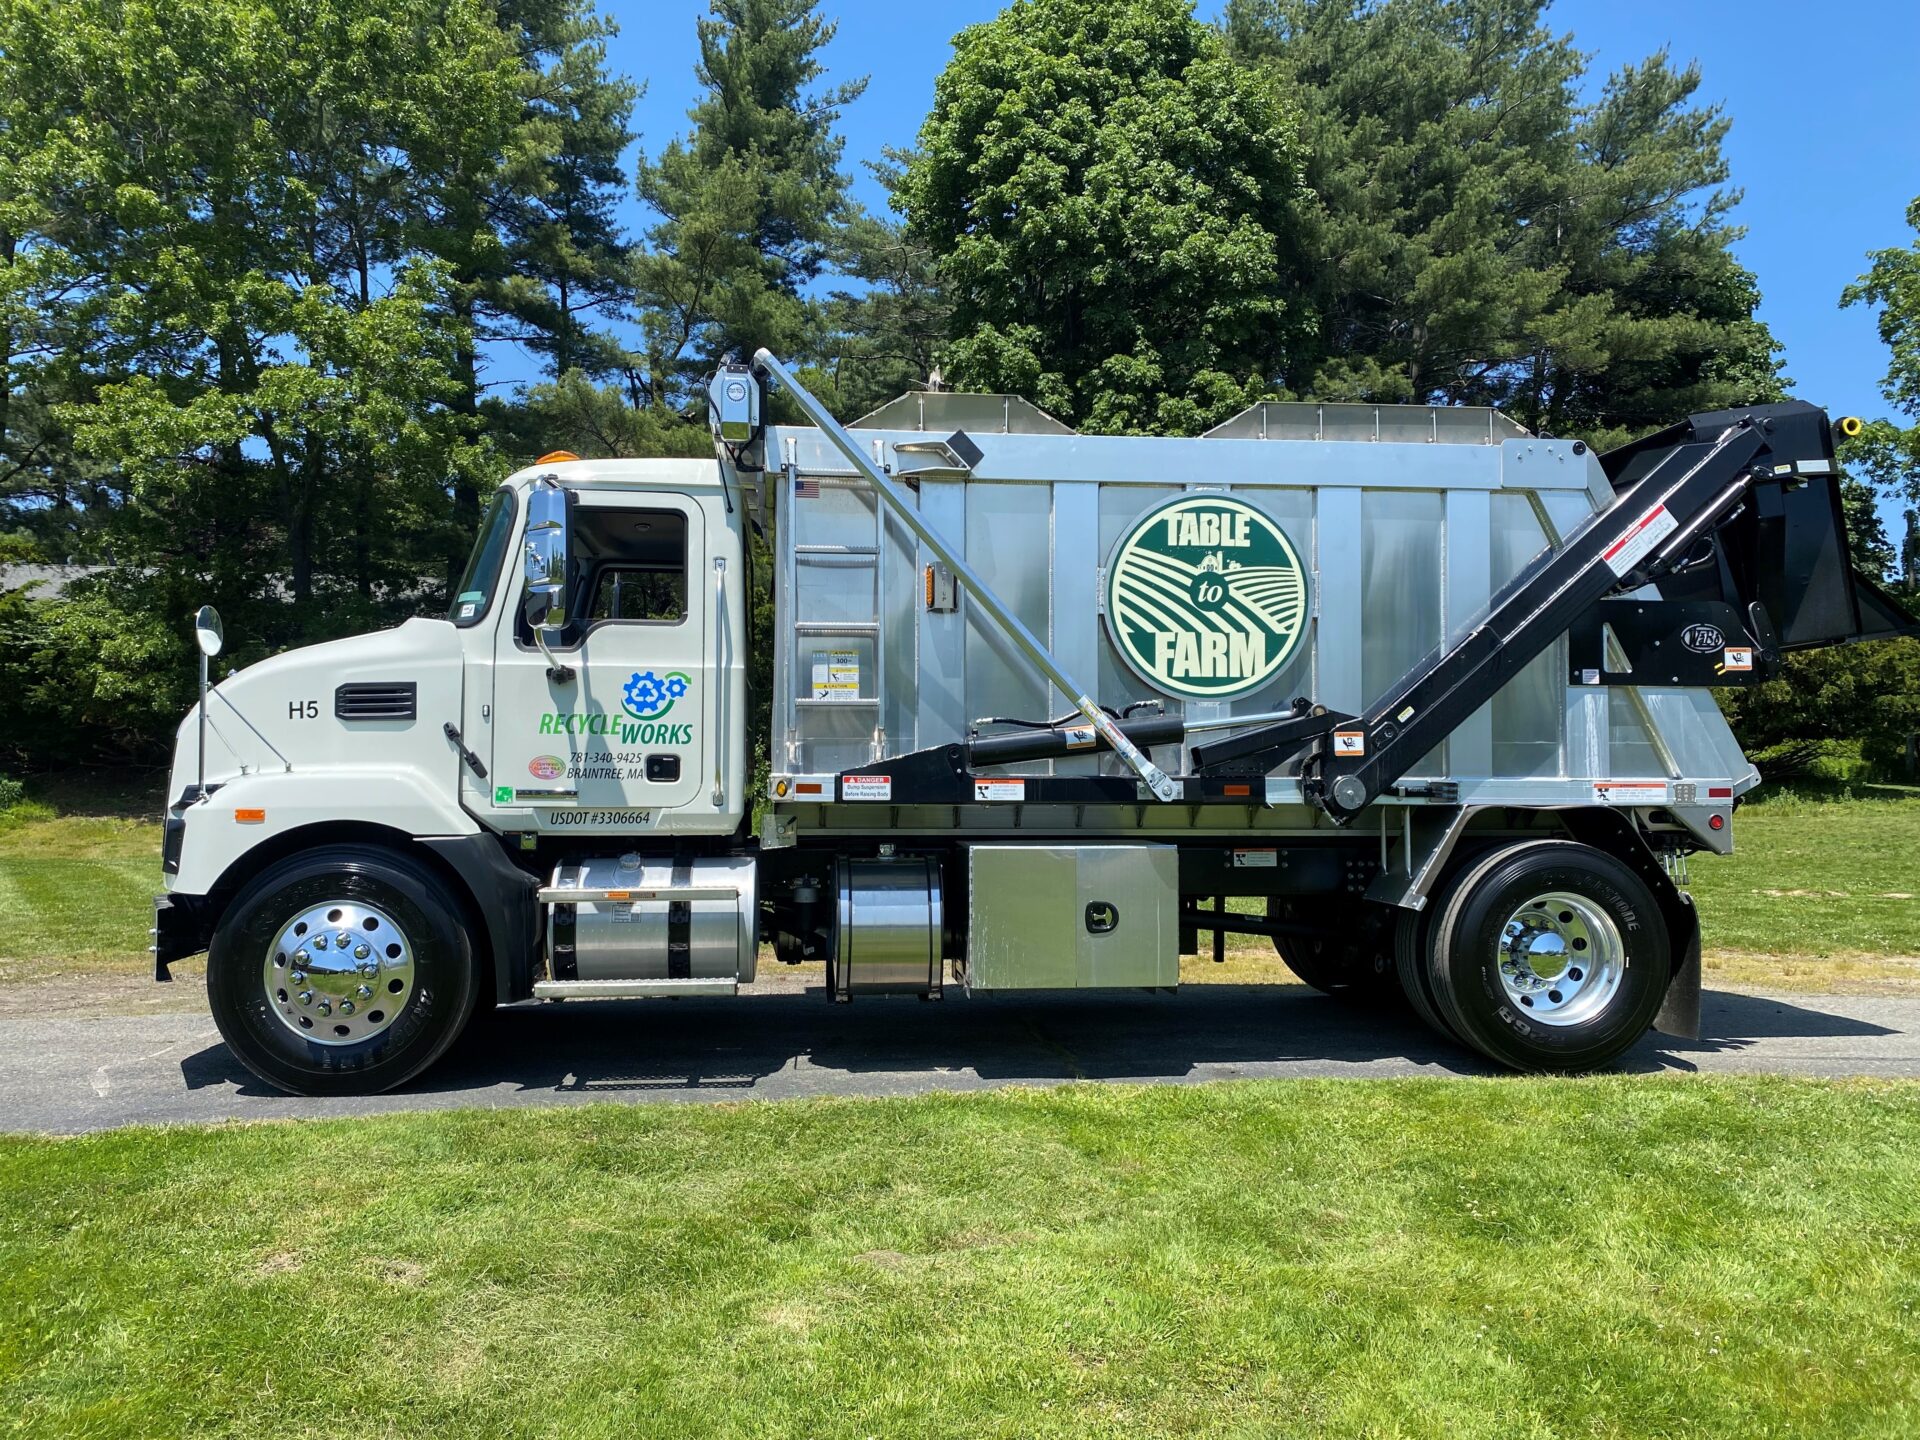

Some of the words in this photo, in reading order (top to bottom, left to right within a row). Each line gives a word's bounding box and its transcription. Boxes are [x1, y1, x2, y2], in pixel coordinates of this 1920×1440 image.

[1163, 512, 1251, 547] TABLE
[1198, 581, 1223, 603] to
[1155, 631, 1265, 678] FARM
[289, 701, 319, 720] H5
[539, 713, 623, 735] RECYCLE
[621, 723, 693, 745] WORKS
[570, 752, 642, 764] 781-340-9425
[567, 768, 625, 780] BRAINTREE,
[629, 768, 644, 780] MA
[550, 811, 590, 825] USDOT
[591, 811, 650, 825] #3306664
